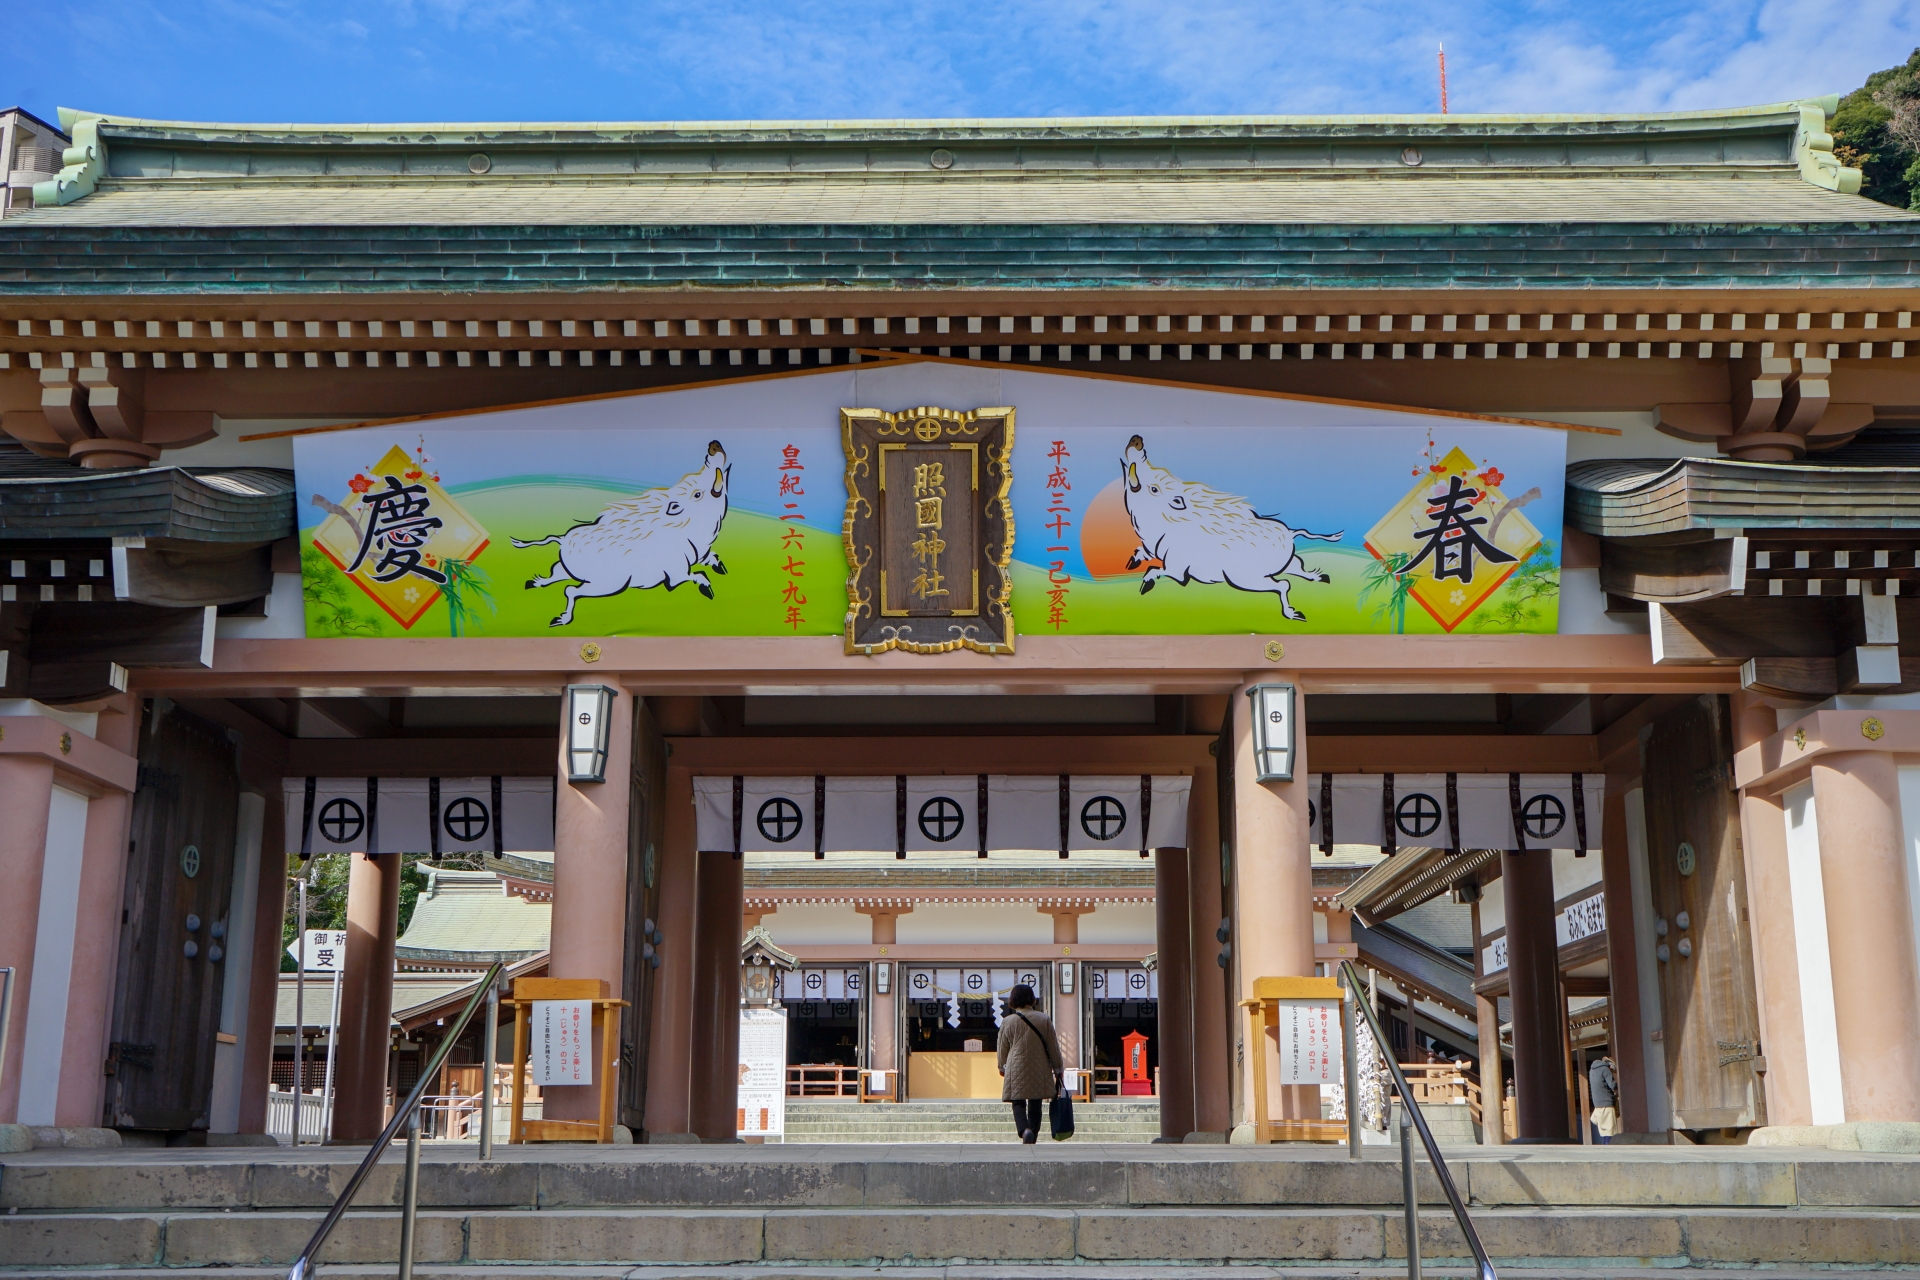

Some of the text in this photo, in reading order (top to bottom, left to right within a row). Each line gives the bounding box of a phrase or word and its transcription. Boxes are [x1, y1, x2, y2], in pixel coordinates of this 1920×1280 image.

[347, 475, 448, 584] 慶
[777, 443, 806, 631] 皇紀二六七九年
[910, 462, 950, 600] 照國神社
[1045, 440, 1072, 631] 平成三十一己亥年
[1389, 475, 1520, 584] 春
[317, 949, 334, 967] 受
[573, 1007, 581, 1080] お参りをもっと楽しむ
[1320, 1006, 1329, 1079] お参りをもっと楽しむ
